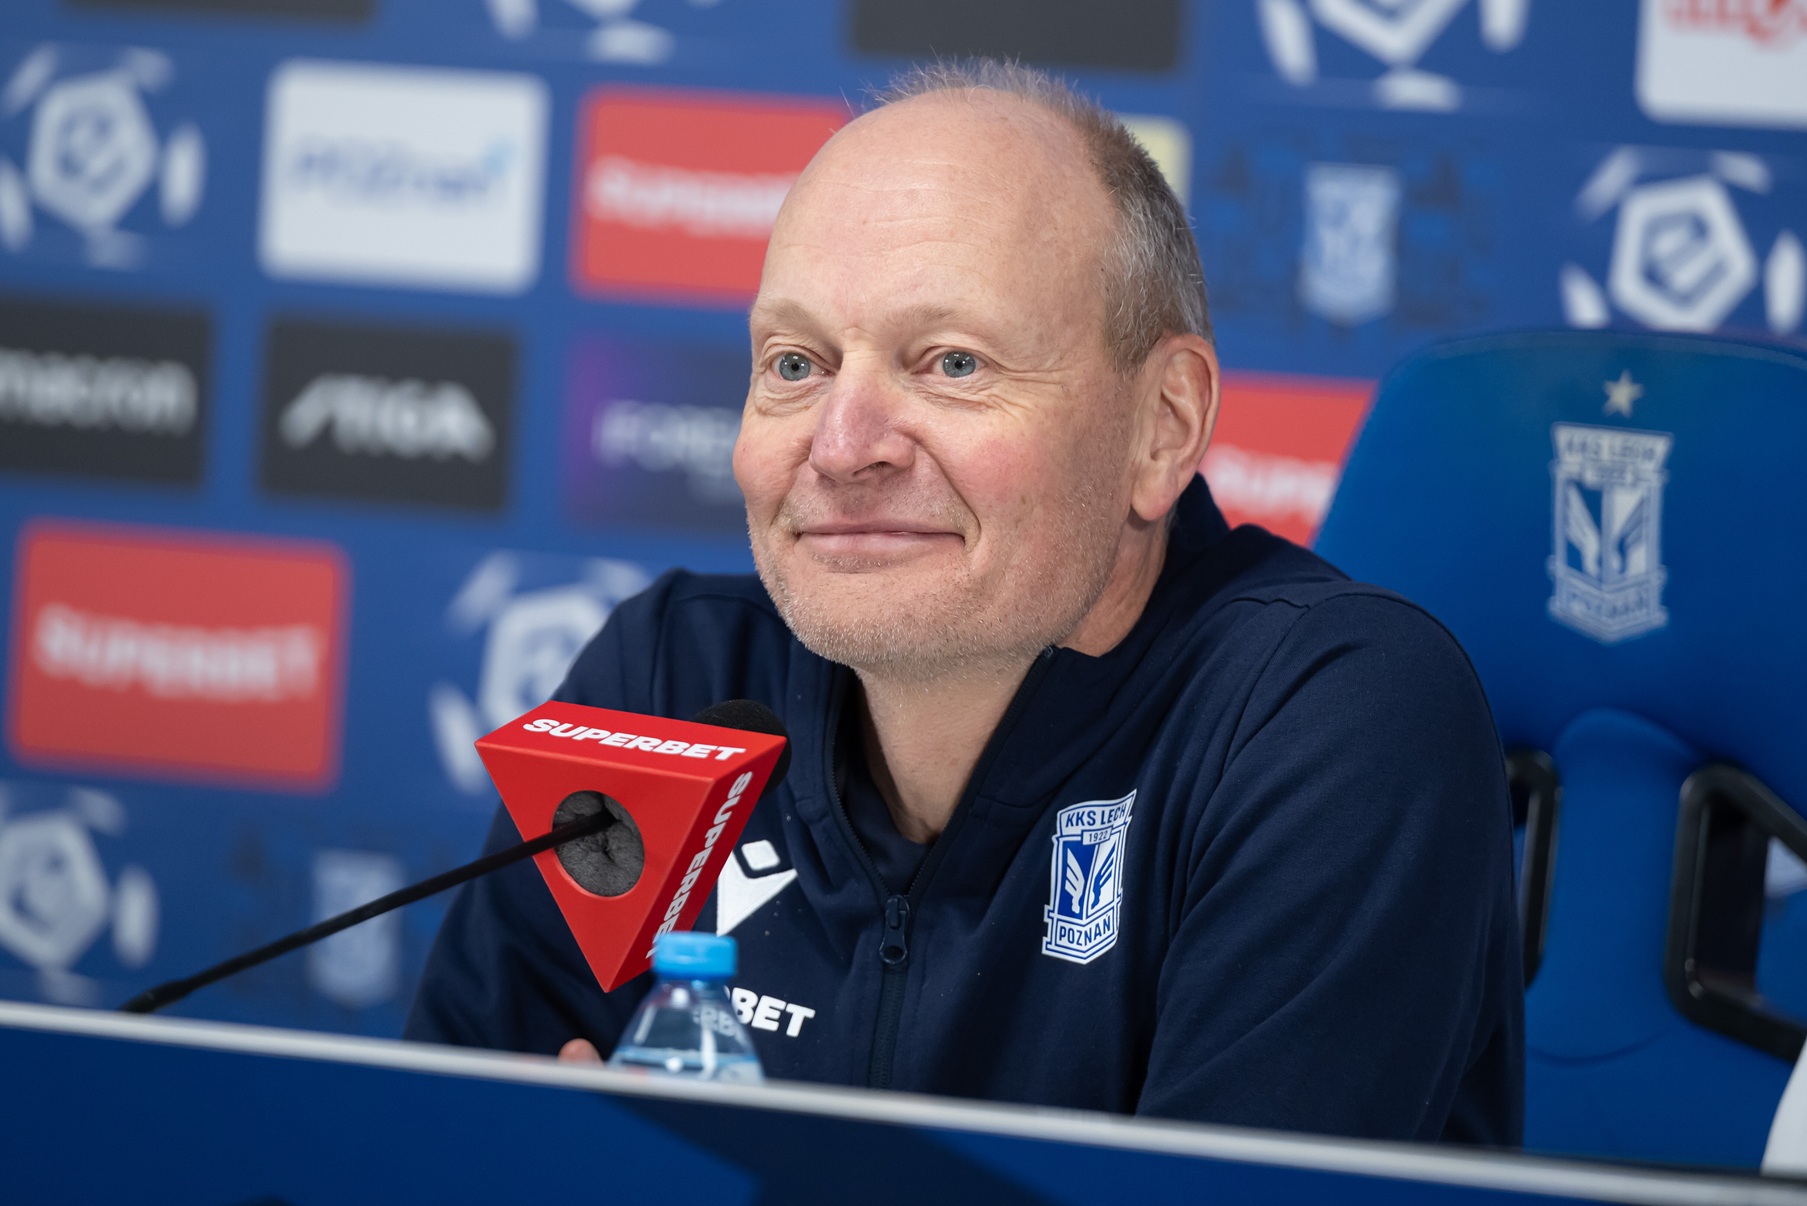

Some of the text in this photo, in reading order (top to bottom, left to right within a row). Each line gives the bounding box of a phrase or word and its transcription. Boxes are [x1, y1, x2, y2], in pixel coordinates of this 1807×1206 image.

[523, 719, 746, 761] SUPERBET
[1066, 804, 1126, 828] KKS LECH
[1089, 831, 1108, 843] 1922
[1059, 914, 1111, 946] POZNAŃ
[724, 985, 816, 1038] BET
